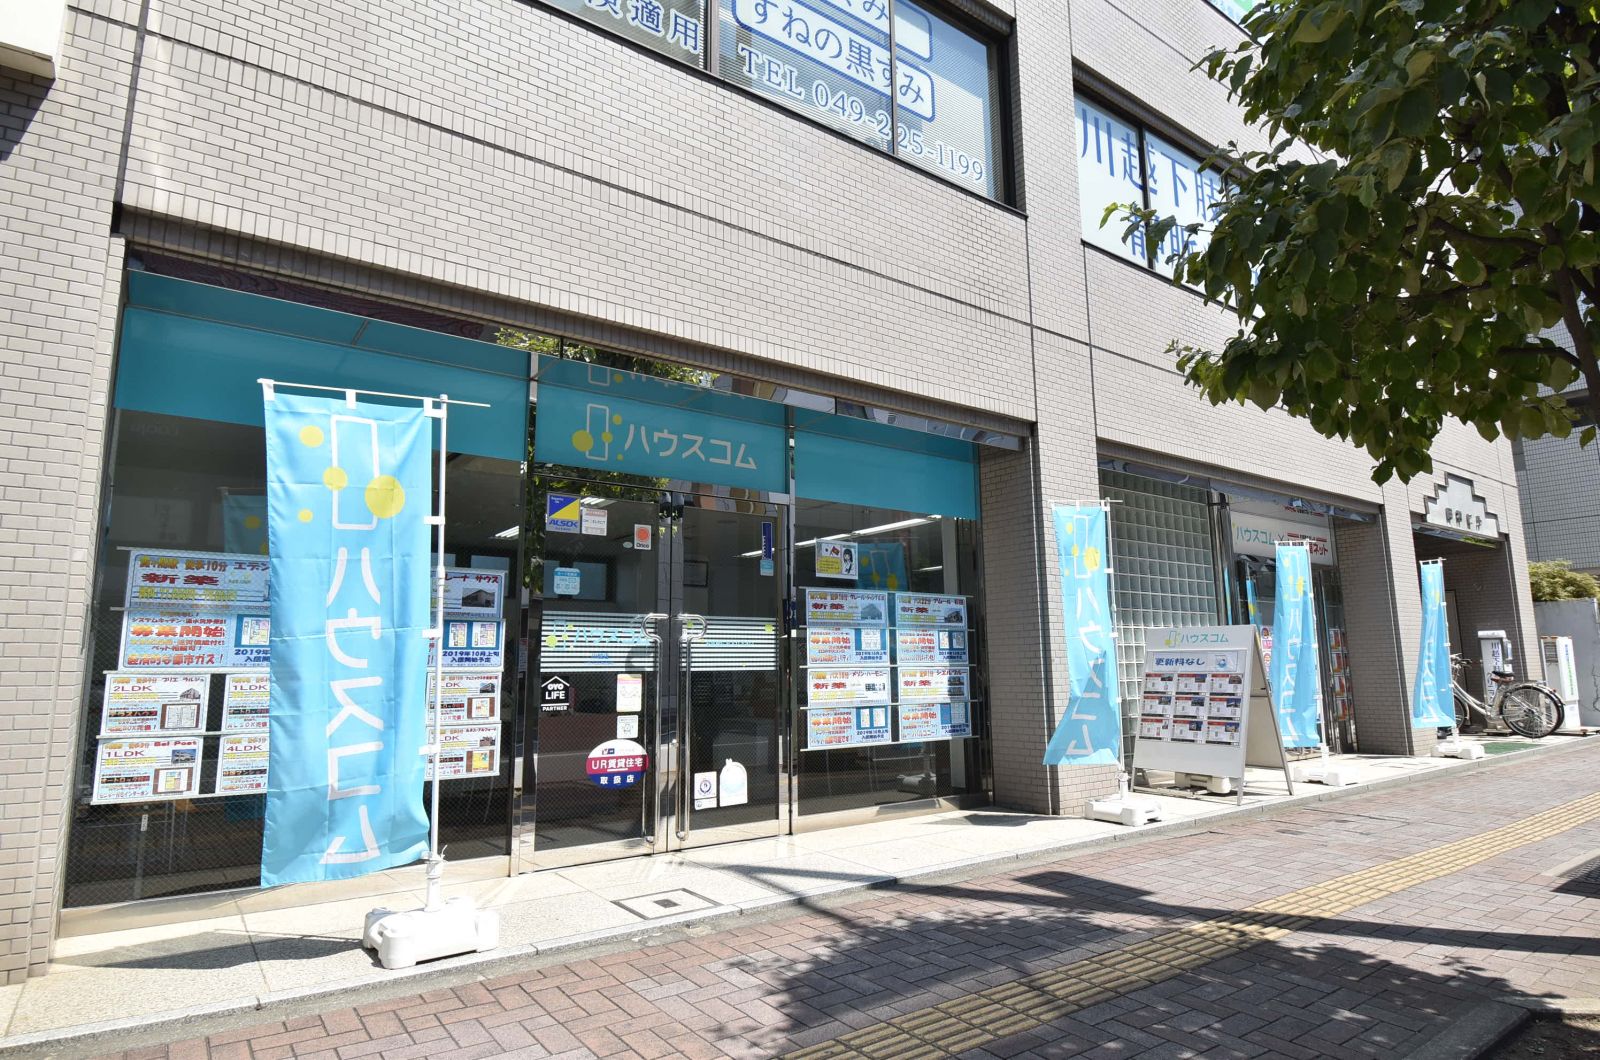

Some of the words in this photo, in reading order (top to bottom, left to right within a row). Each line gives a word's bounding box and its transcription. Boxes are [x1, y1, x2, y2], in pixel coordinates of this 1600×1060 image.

[739, 45, 804, 98] TEL
[814, 82, 984, 181] 049-225-1199
[624, 424, 758, 470] ハウスコム
[549, 520, 578, 528] ALSOK
[141, 573, 219, 585] 新築
[1181, 632, 1229, 644] ハウスコム
[1155, 657, 1206, 667] 更新料なし
[547, 683, 565, 691] OYO
[545, 691, 566, 700] LIFE
[226, 744, 262, 752] 4LDK
[591, 757, 643, 770] UR賃貸住宅
